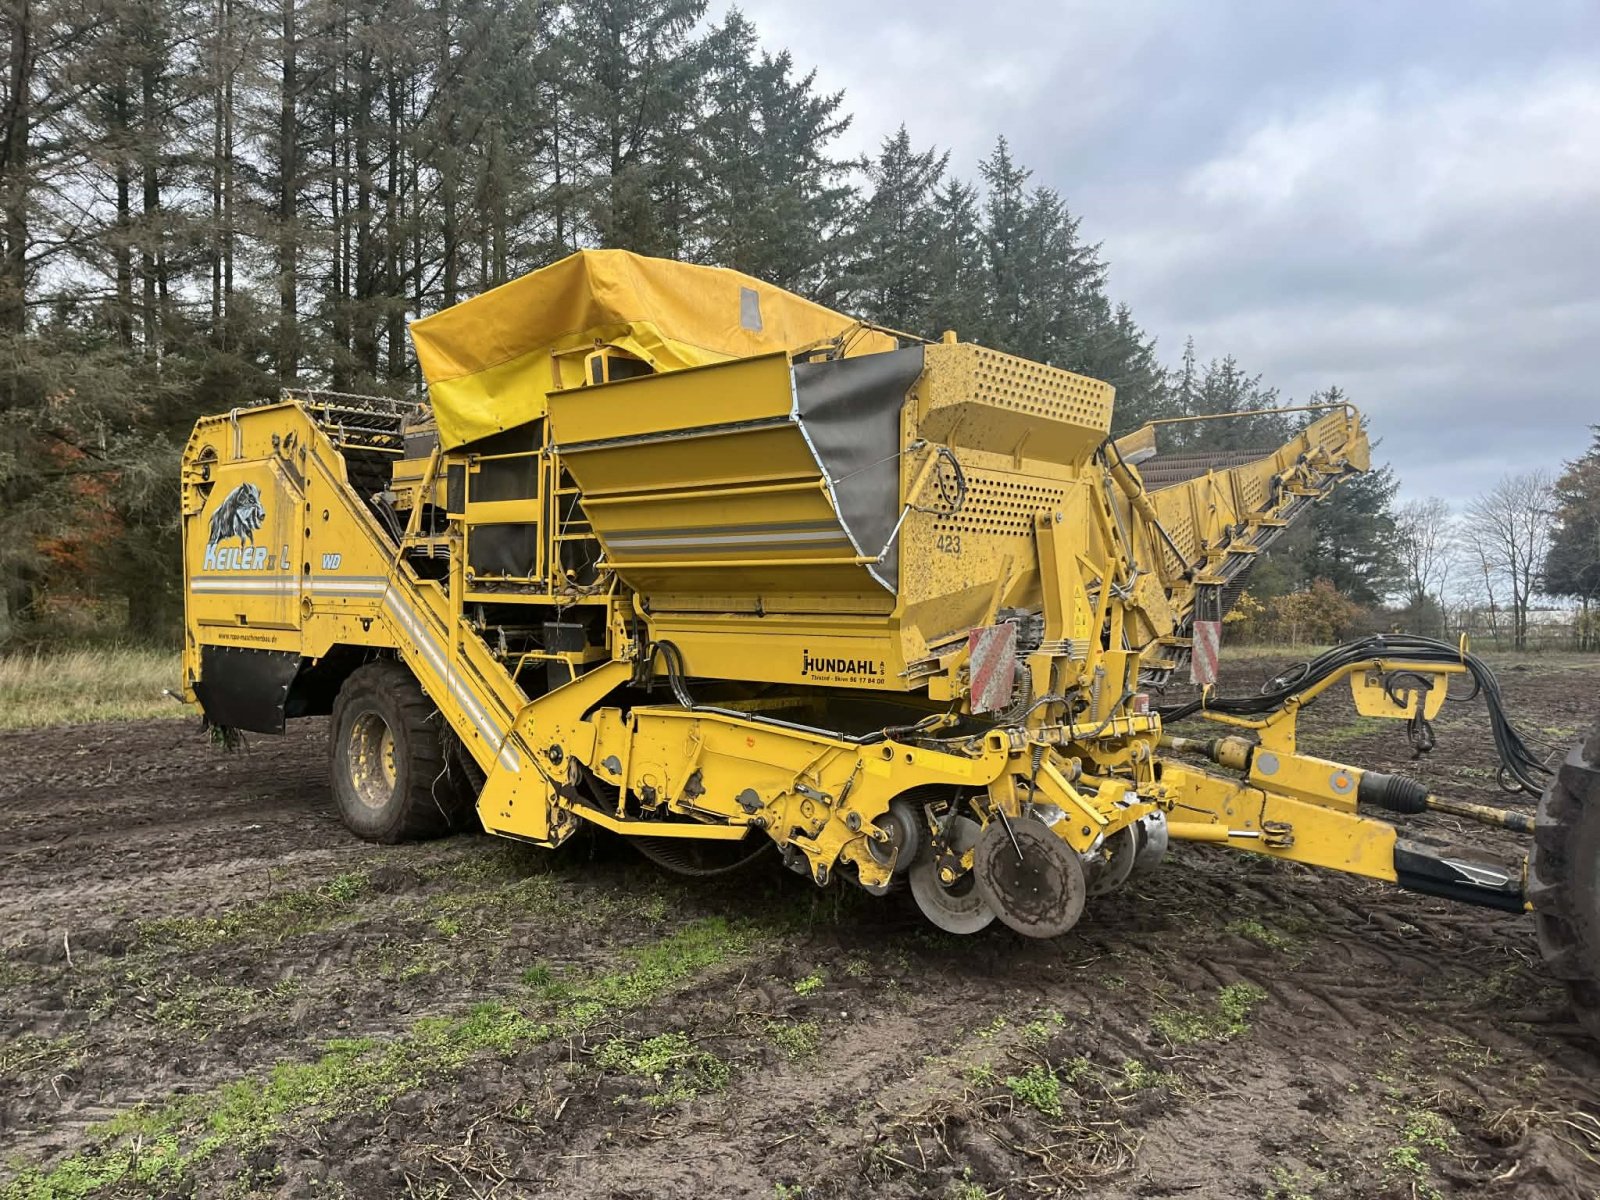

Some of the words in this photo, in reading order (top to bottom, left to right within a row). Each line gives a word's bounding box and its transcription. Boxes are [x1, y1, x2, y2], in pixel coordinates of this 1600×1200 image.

[936, 534, 960, 553] 423
[203, 543, 267, 571] KEILER
[280, 544, 290, 570] L
[321, 553, 341, 570] WD
